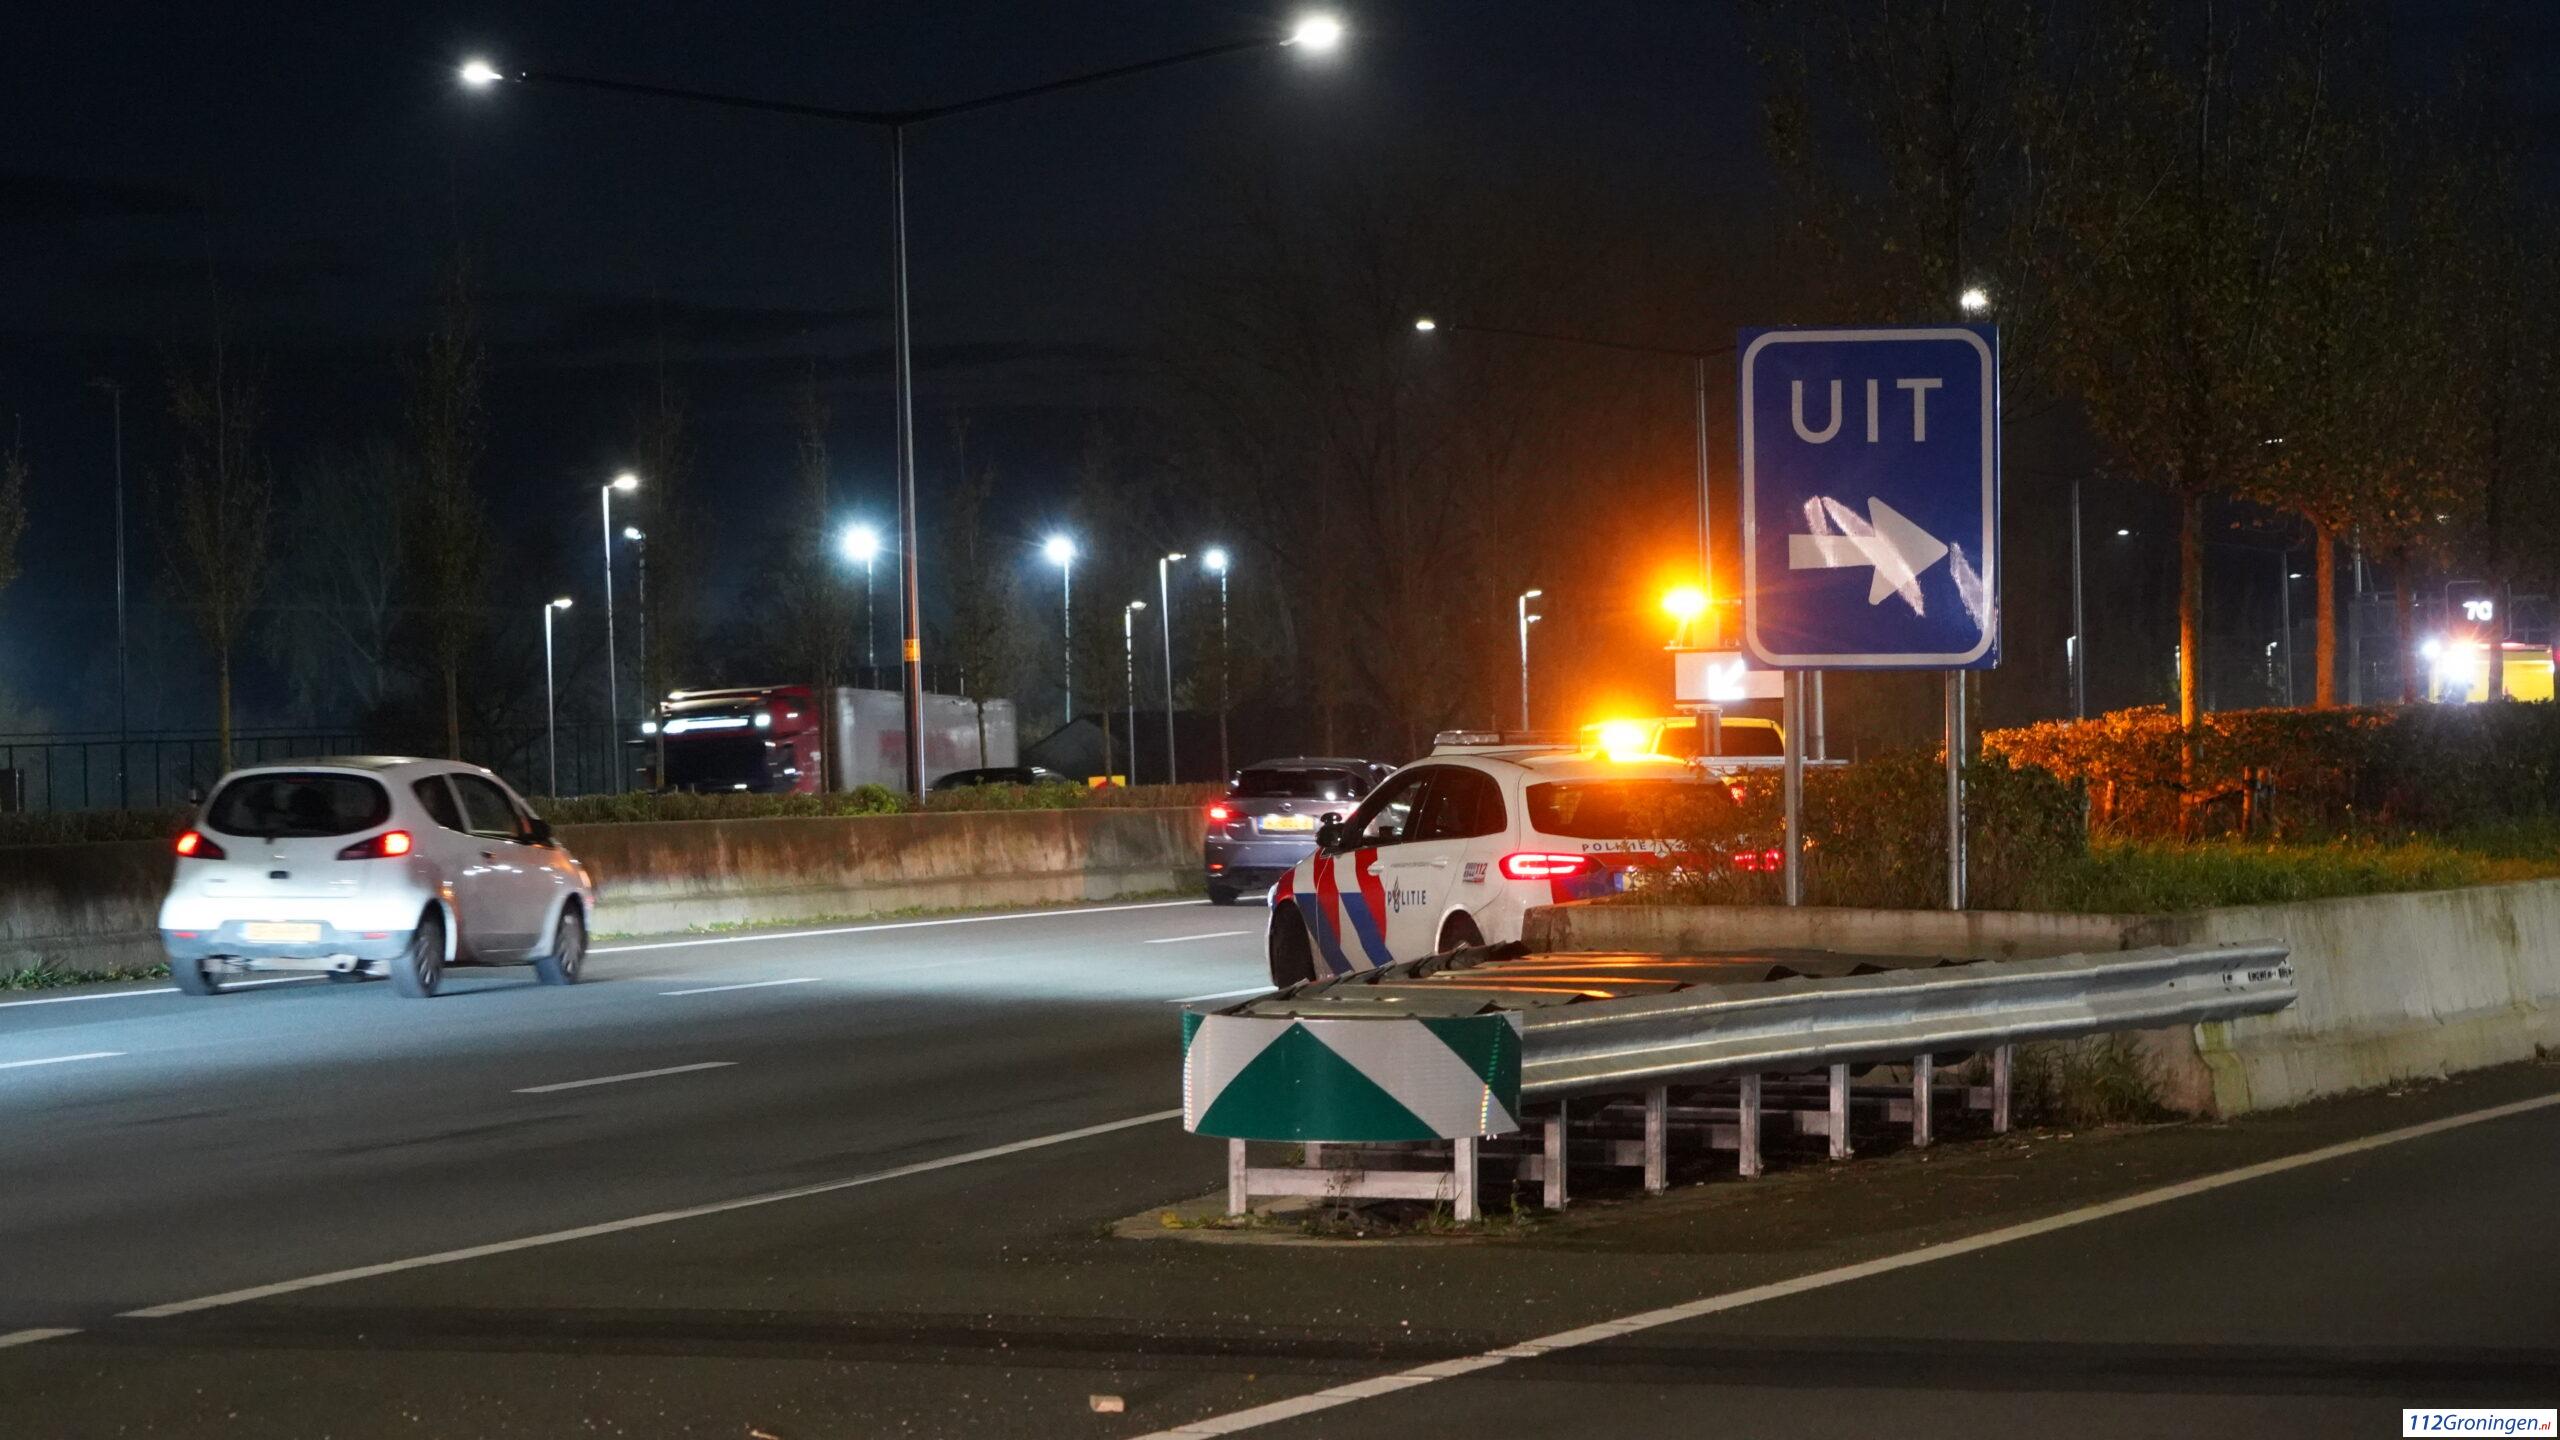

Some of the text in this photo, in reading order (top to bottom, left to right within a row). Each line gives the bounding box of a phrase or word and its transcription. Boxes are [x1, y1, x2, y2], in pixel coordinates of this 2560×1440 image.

[1791, 378, 1943, 444] UIT
[2462, 600, 2493, 621] 70
[1582, 840, 1647, 853] POLIIE
